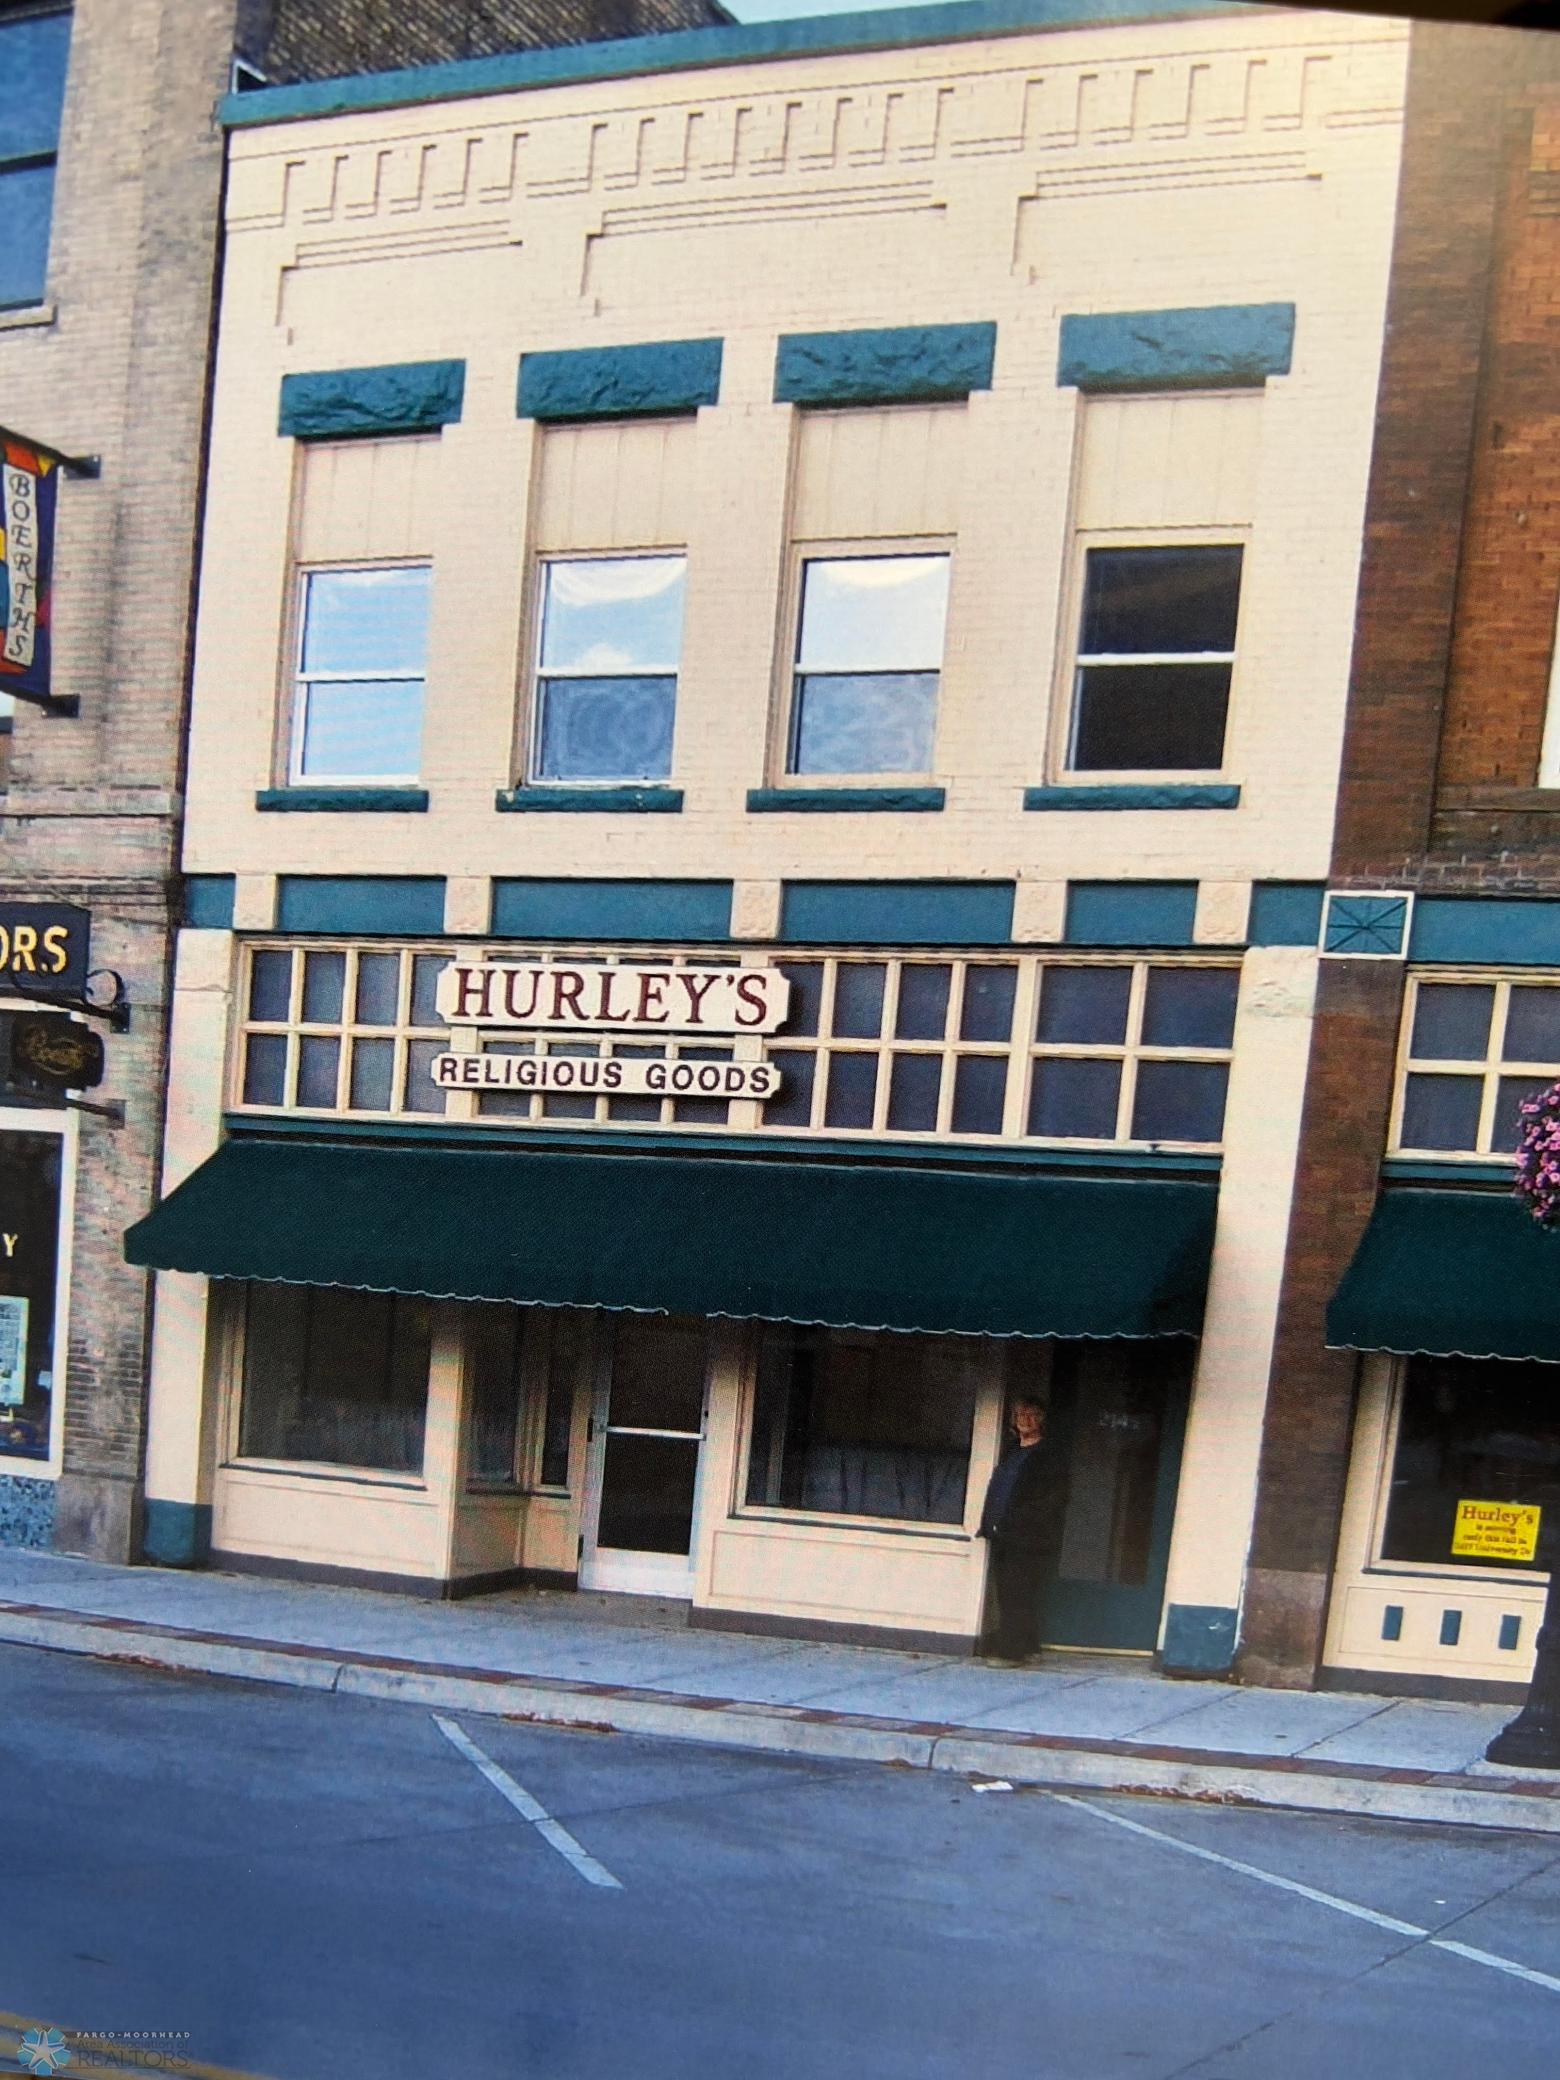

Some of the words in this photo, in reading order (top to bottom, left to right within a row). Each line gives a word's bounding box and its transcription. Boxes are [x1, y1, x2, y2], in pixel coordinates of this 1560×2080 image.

[451, 967, 768, 1027] HURLEY'S
[438, 1057, 623, 1088] RELIGIOUS
[645, 1064, 771, 1093] GOODS
[1462, 1505, 1534, 1526] Hurley's
